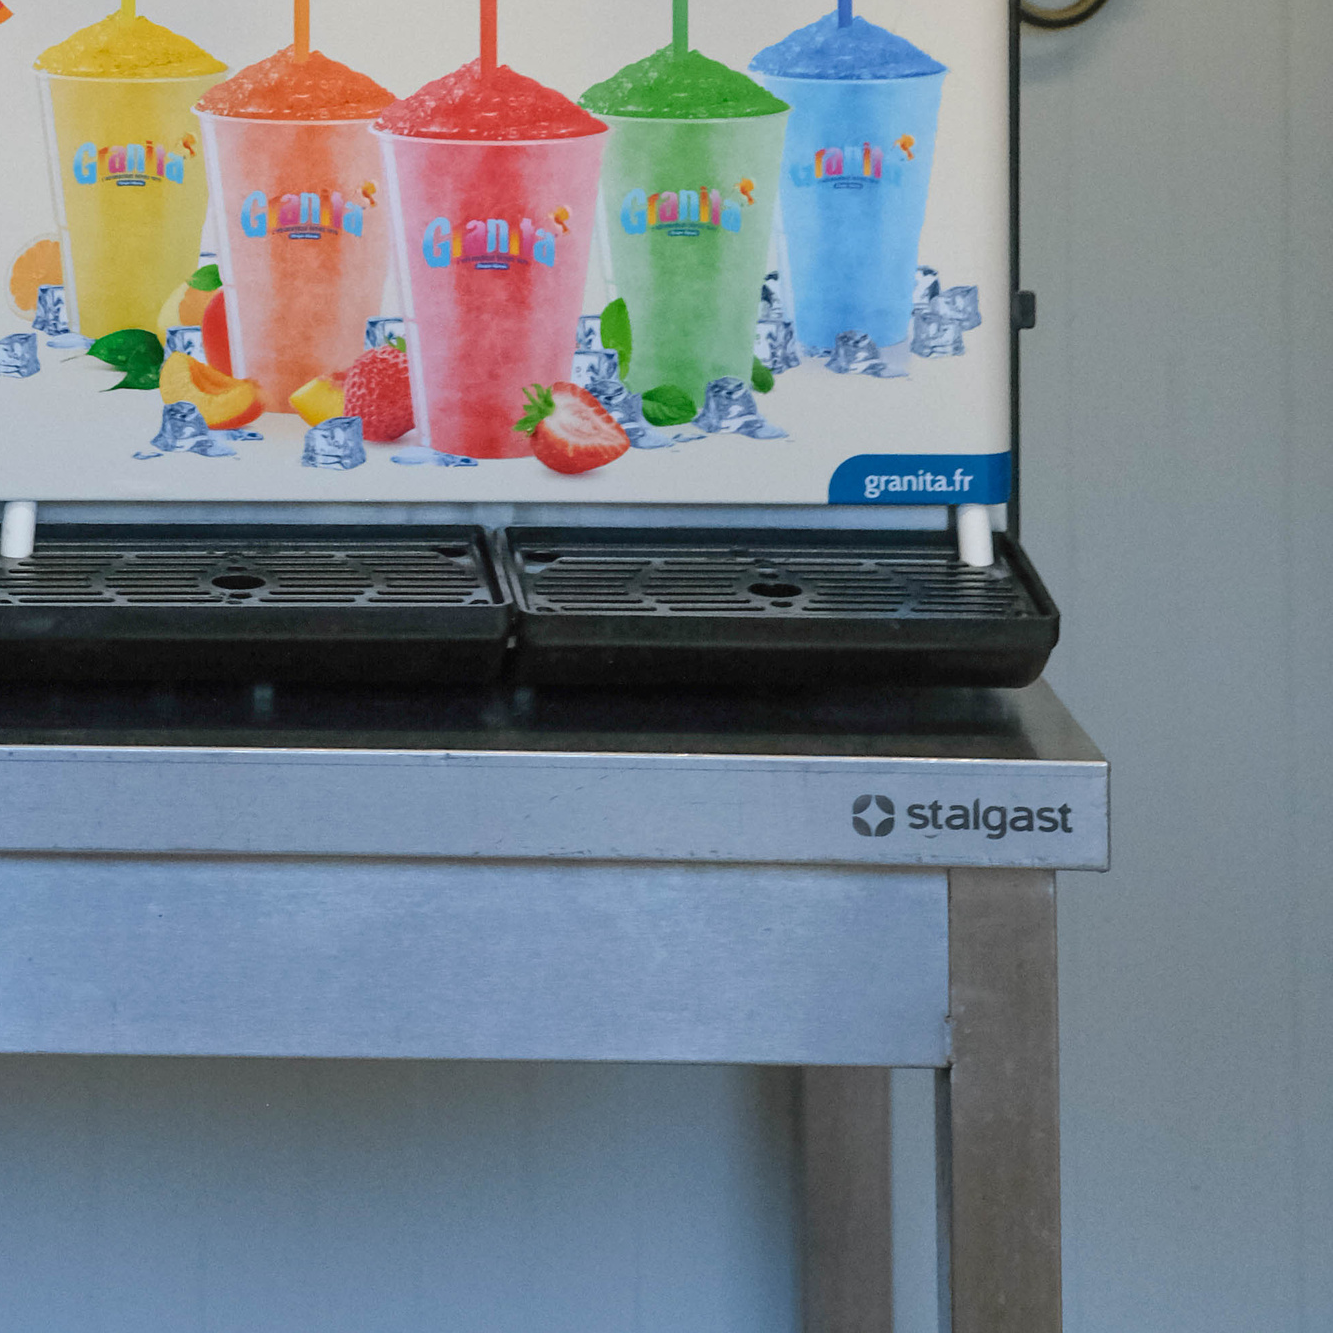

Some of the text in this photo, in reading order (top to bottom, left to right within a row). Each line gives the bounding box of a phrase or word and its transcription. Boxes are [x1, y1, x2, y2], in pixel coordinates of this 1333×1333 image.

[73, 140, 184, 184] Granita
[241, 189, 363, 238] Granita
[620, 186, 742, 235] Granita
[864, 468, 974, 498] granita.fr
[907, 798, 1073, 839] stalgast
